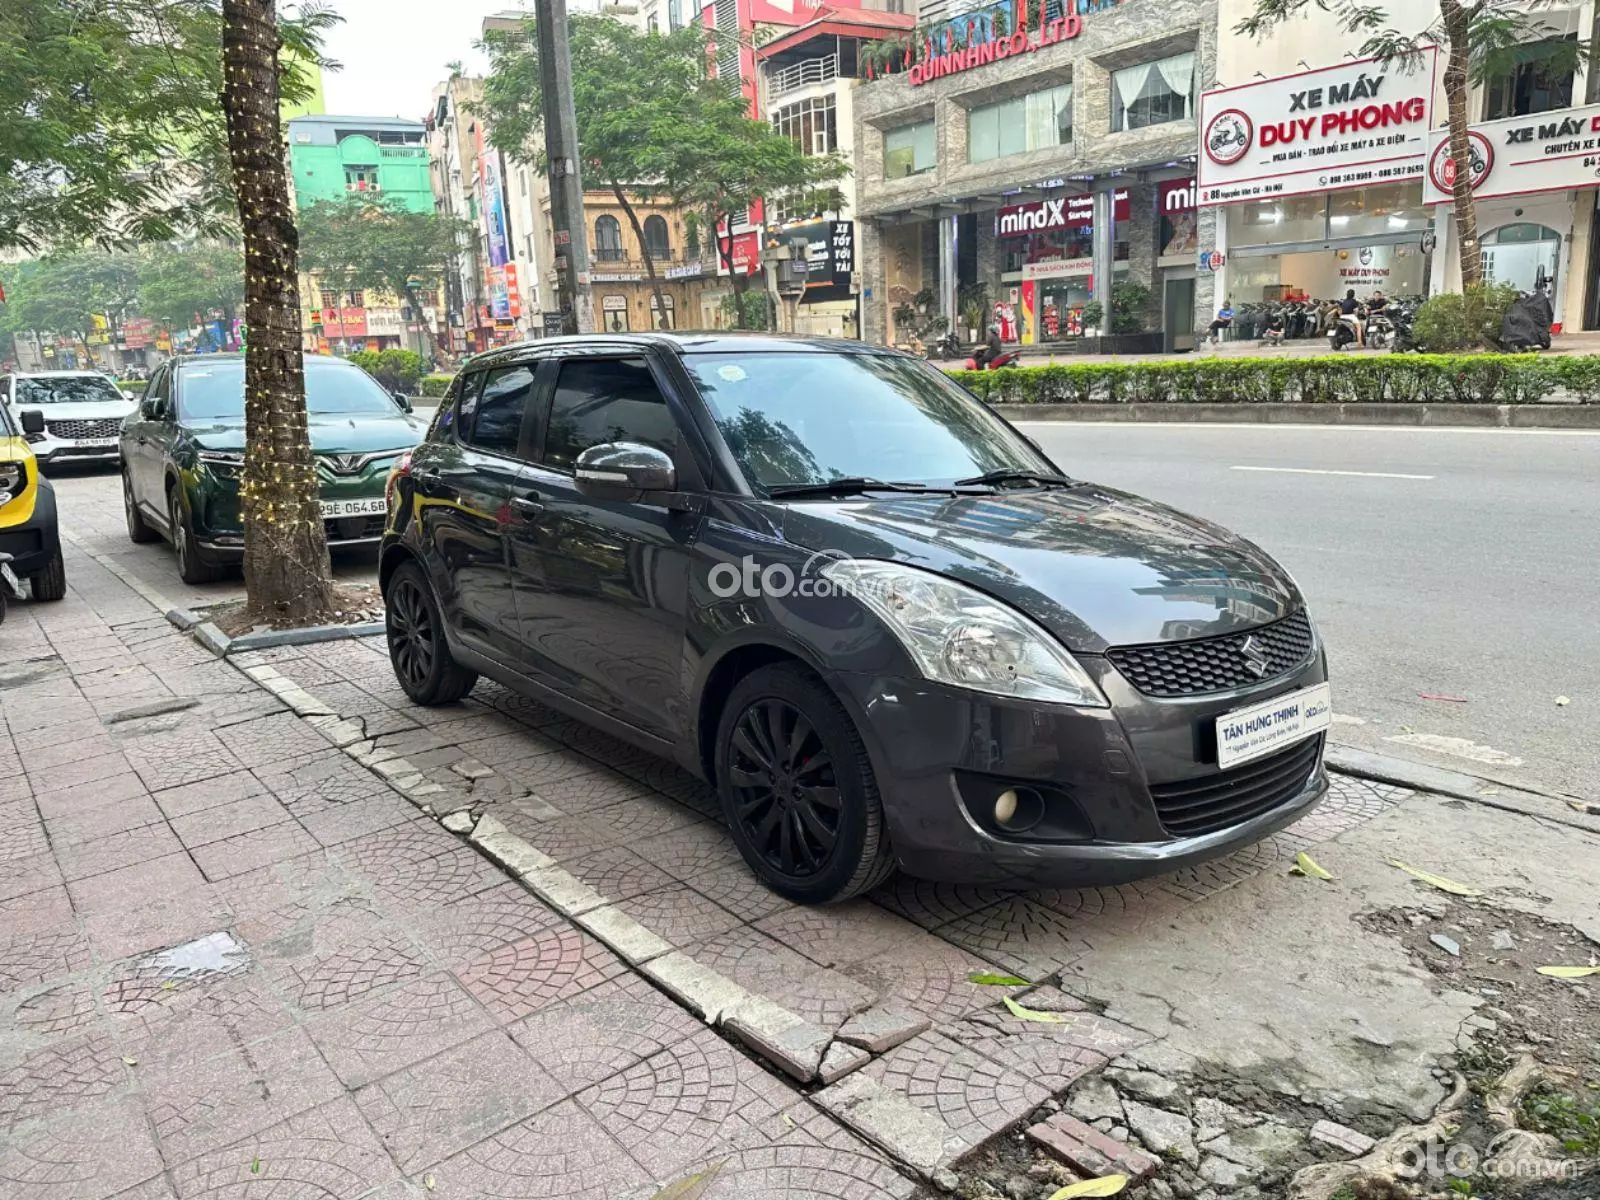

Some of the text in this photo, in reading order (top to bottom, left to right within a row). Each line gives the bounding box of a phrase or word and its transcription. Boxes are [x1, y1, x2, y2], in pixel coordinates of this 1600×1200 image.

[1289, 73, 1385, 113] XE MÁY
[1260, 116, 1317, 148] DUY
[1321, 97, 1426, 137] PHONG
[1506, 127, 1535, 145] XE
[1538, 116, 1588, 140] MÁY
[1272, 151, 1287, 162] MUA
[1308, 147, 1325, 157] TRAO
[1340, 143, 1349, 152] XE
[1351, 139, 1367, 151] MÁY
[1368, 139, 1374, 147] &
[1375, 136, 1386, 147] XE
[1583, 139, 1596, 150] XE
[1583, 156, 1596, 168] 84
[1210, 189, 1220, 199] 88
[835, 223, 848, 234] XE
[1001, 199, 1065, 234] mindX
[1223, 721, 1244, 741] TÂN
[1246, 713, 1272, 735] HƯNG
[1272, 704, 1299, 725] THỊNH
